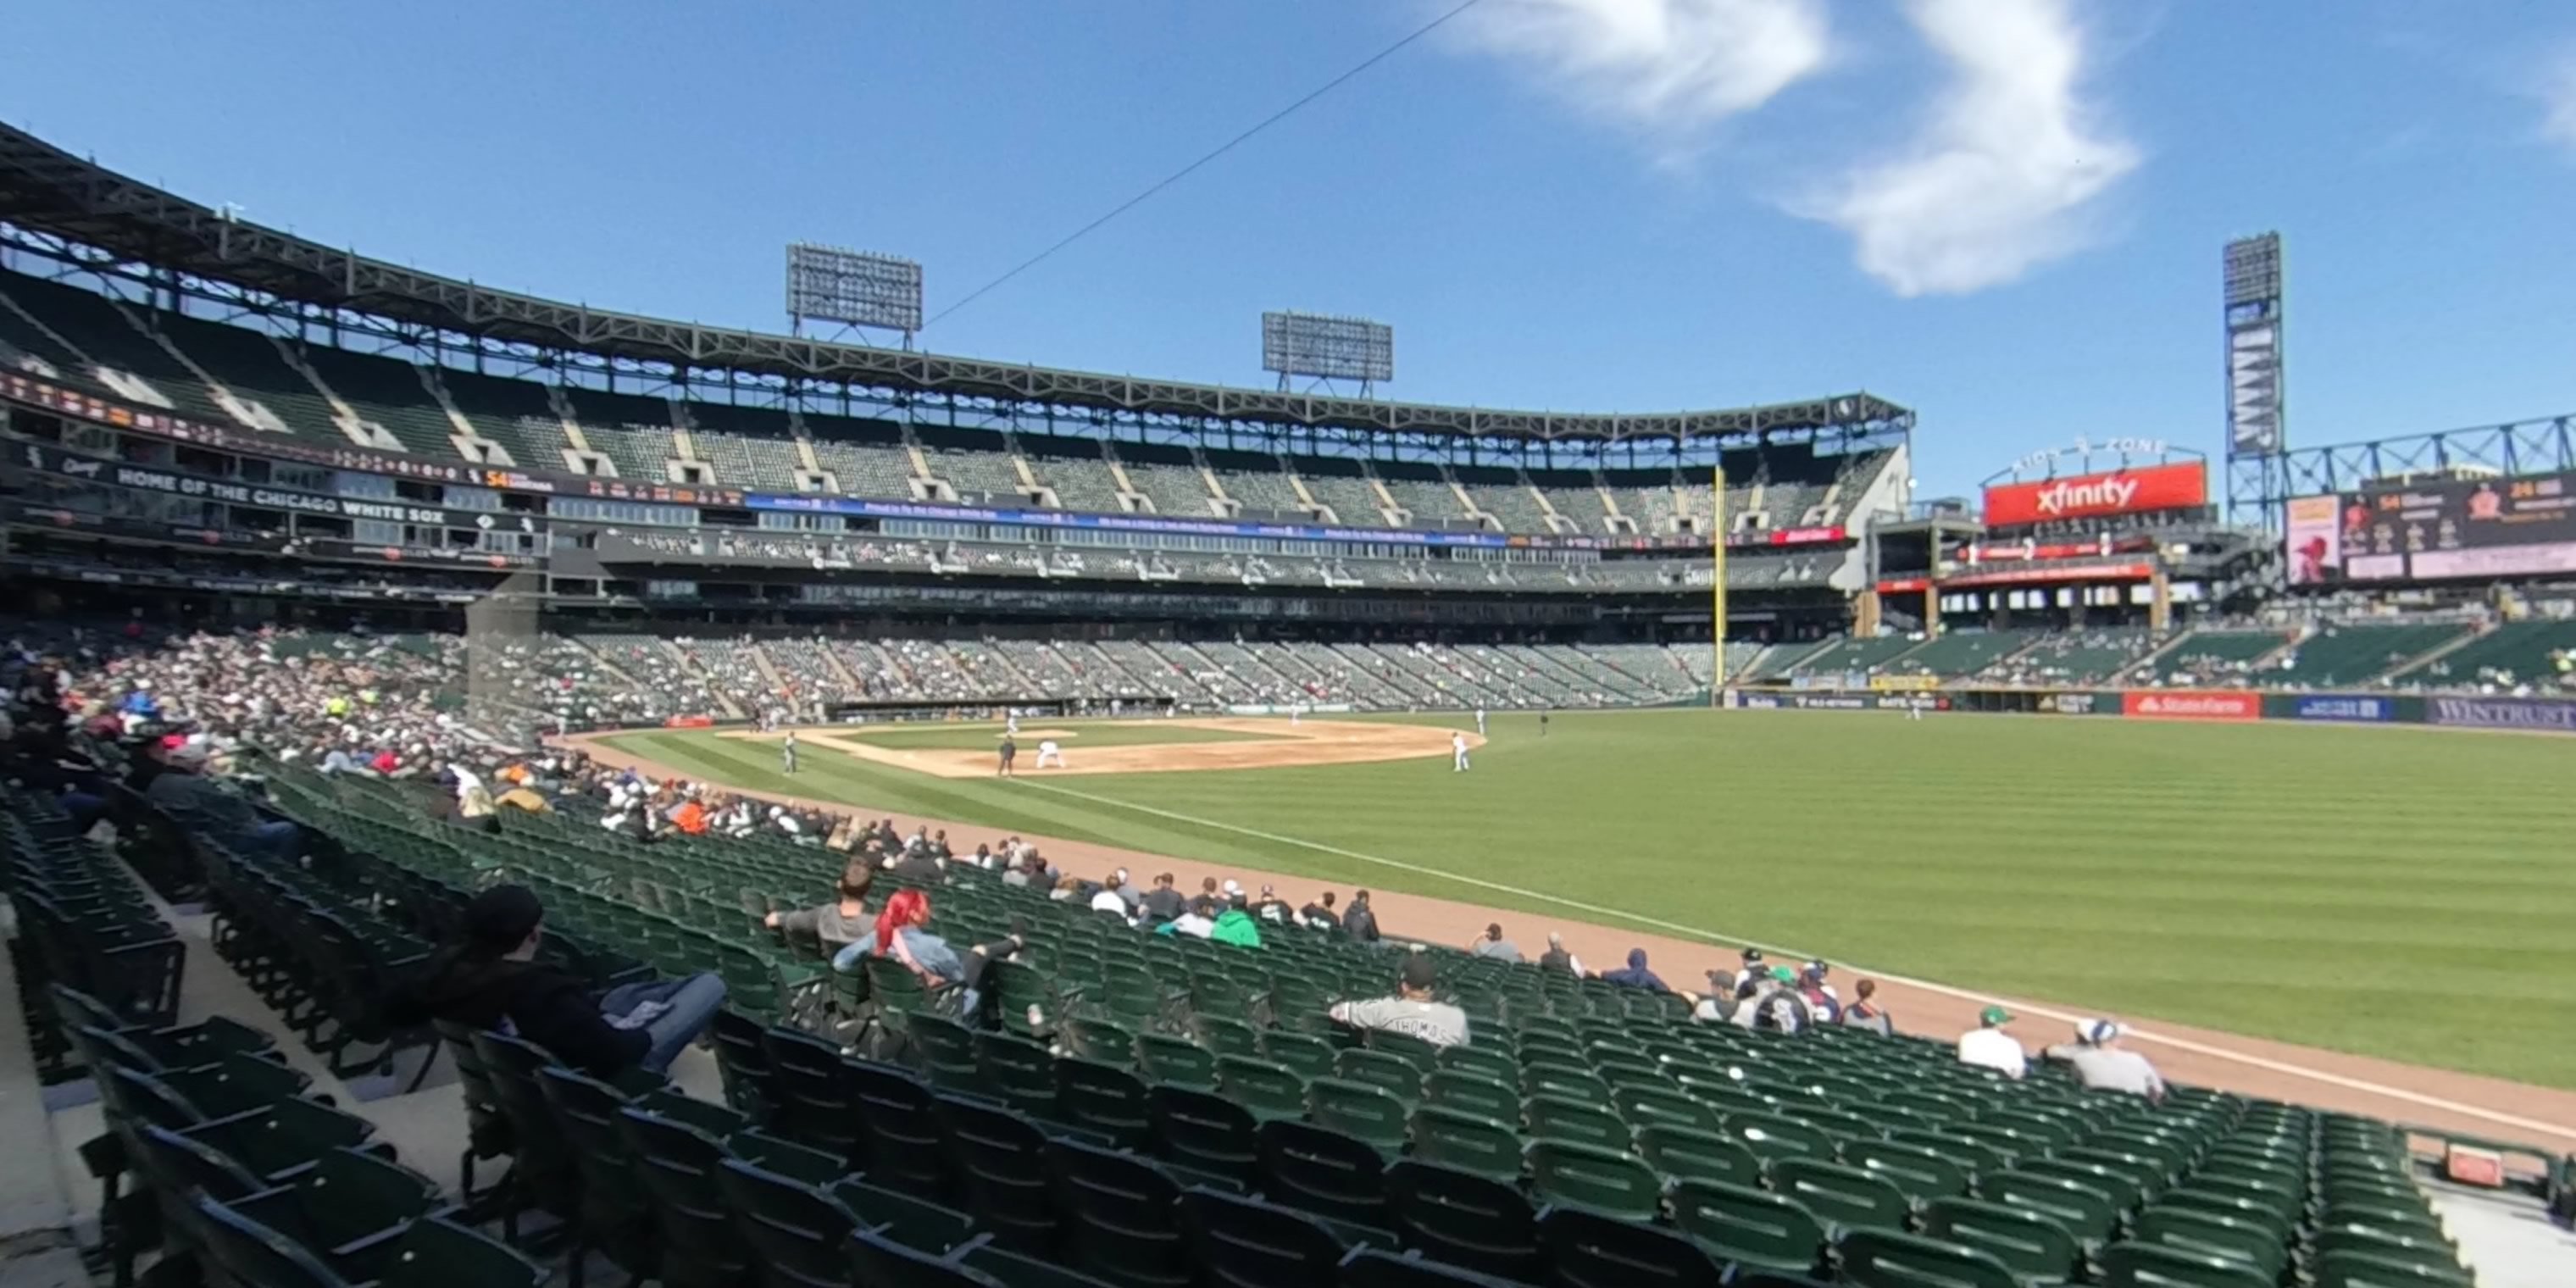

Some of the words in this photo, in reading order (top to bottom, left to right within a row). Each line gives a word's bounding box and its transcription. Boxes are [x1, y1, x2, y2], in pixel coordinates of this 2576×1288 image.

[2105, 437, 2168, 454] ZONE
[486, 470, 508, 486] 54
[117, 468, 177, 491] HOME
[180, 478, 207, 494] OF
[209, 483, 249, 502] THE
[253, 488, 337, 513] CHICAGO
[341, 502, 402, 520] WHITE
[408, 509, 445, 524] SOX
[2037, 476, 2138, 515] xfinity
[2162, 697, 2202, 713] State
[2202, 697, 2245, 713] Farm
[2436, 697, 2574, 728] WINTRUST
[1396, 1020, 1448, 1041] THOMAS
